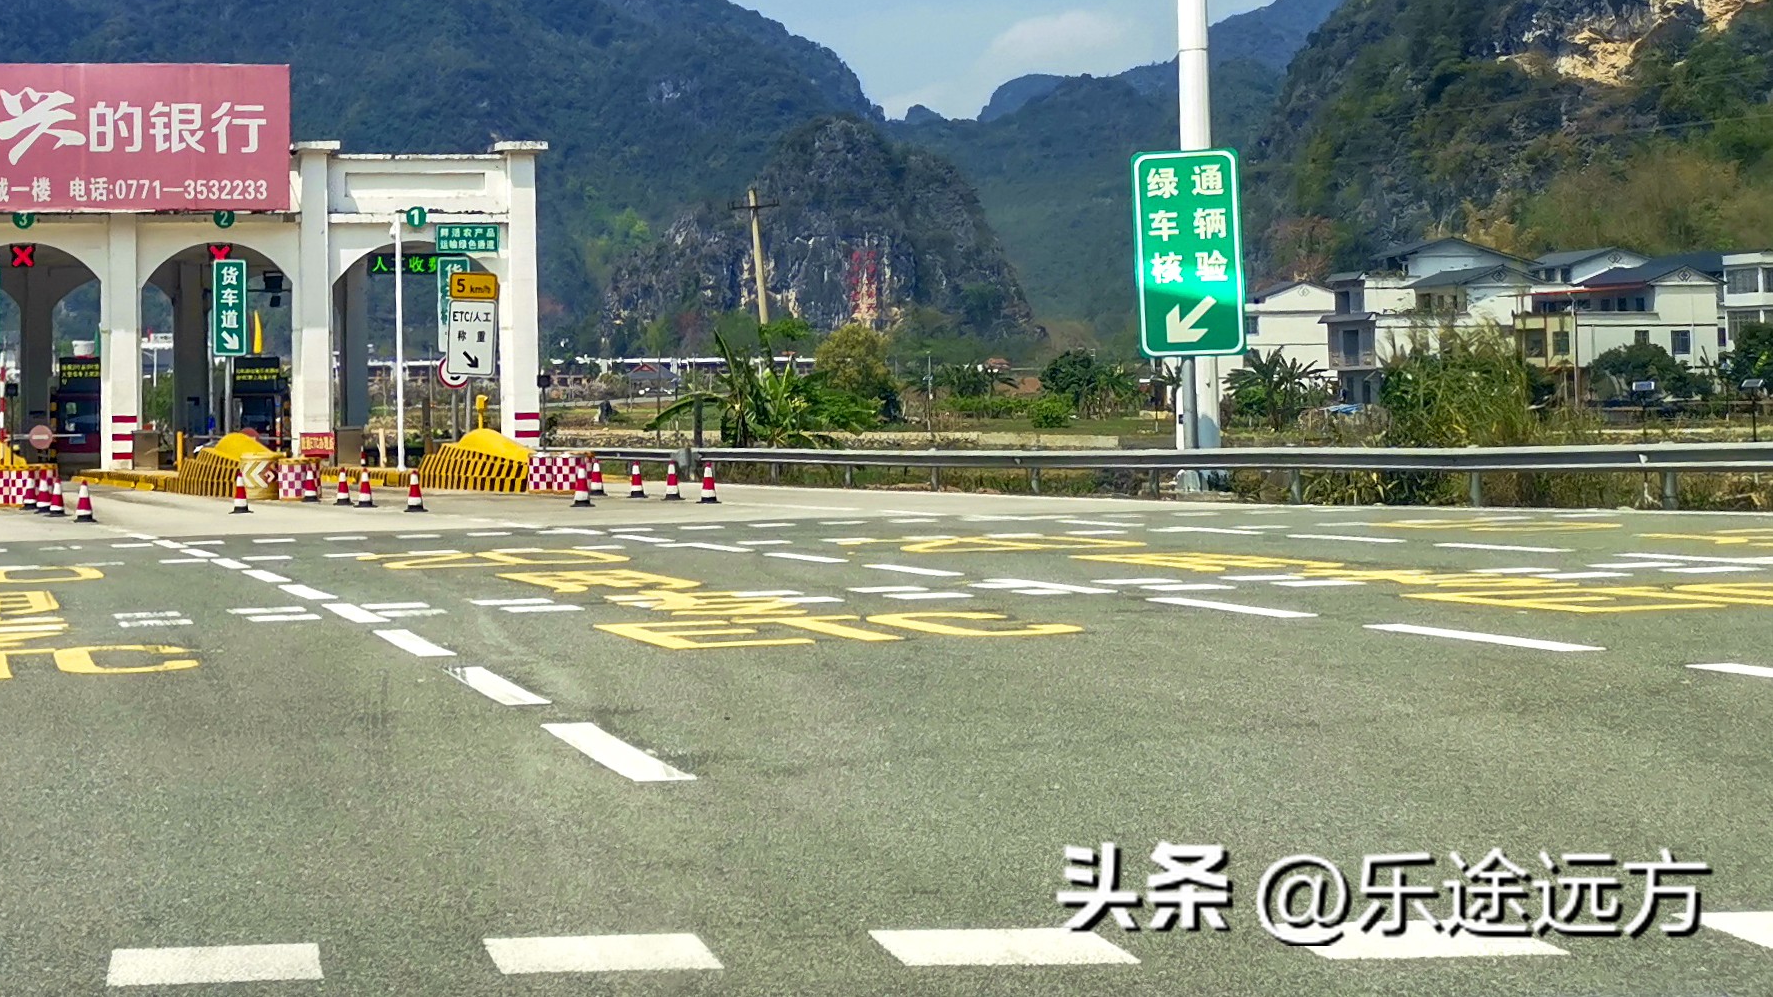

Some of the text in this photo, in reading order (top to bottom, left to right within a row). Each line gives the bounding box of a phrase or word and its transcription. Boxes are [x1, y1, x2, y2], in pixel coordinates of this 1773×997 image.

[1146, 164, 1225, 199] 绿通
[219, 210, 229, 226] 2
[410, 209, 420, 226] 1
[1147, 207, 1227, 242] 车辆
[1150, 249, 1229, 284] 核验
[220, 265, 240, 329] 货车道
[457, 278, 466, 293] 5
[452, 311, 492, 322] ETC/人工
[593, 610, 1086, 650] ETC
